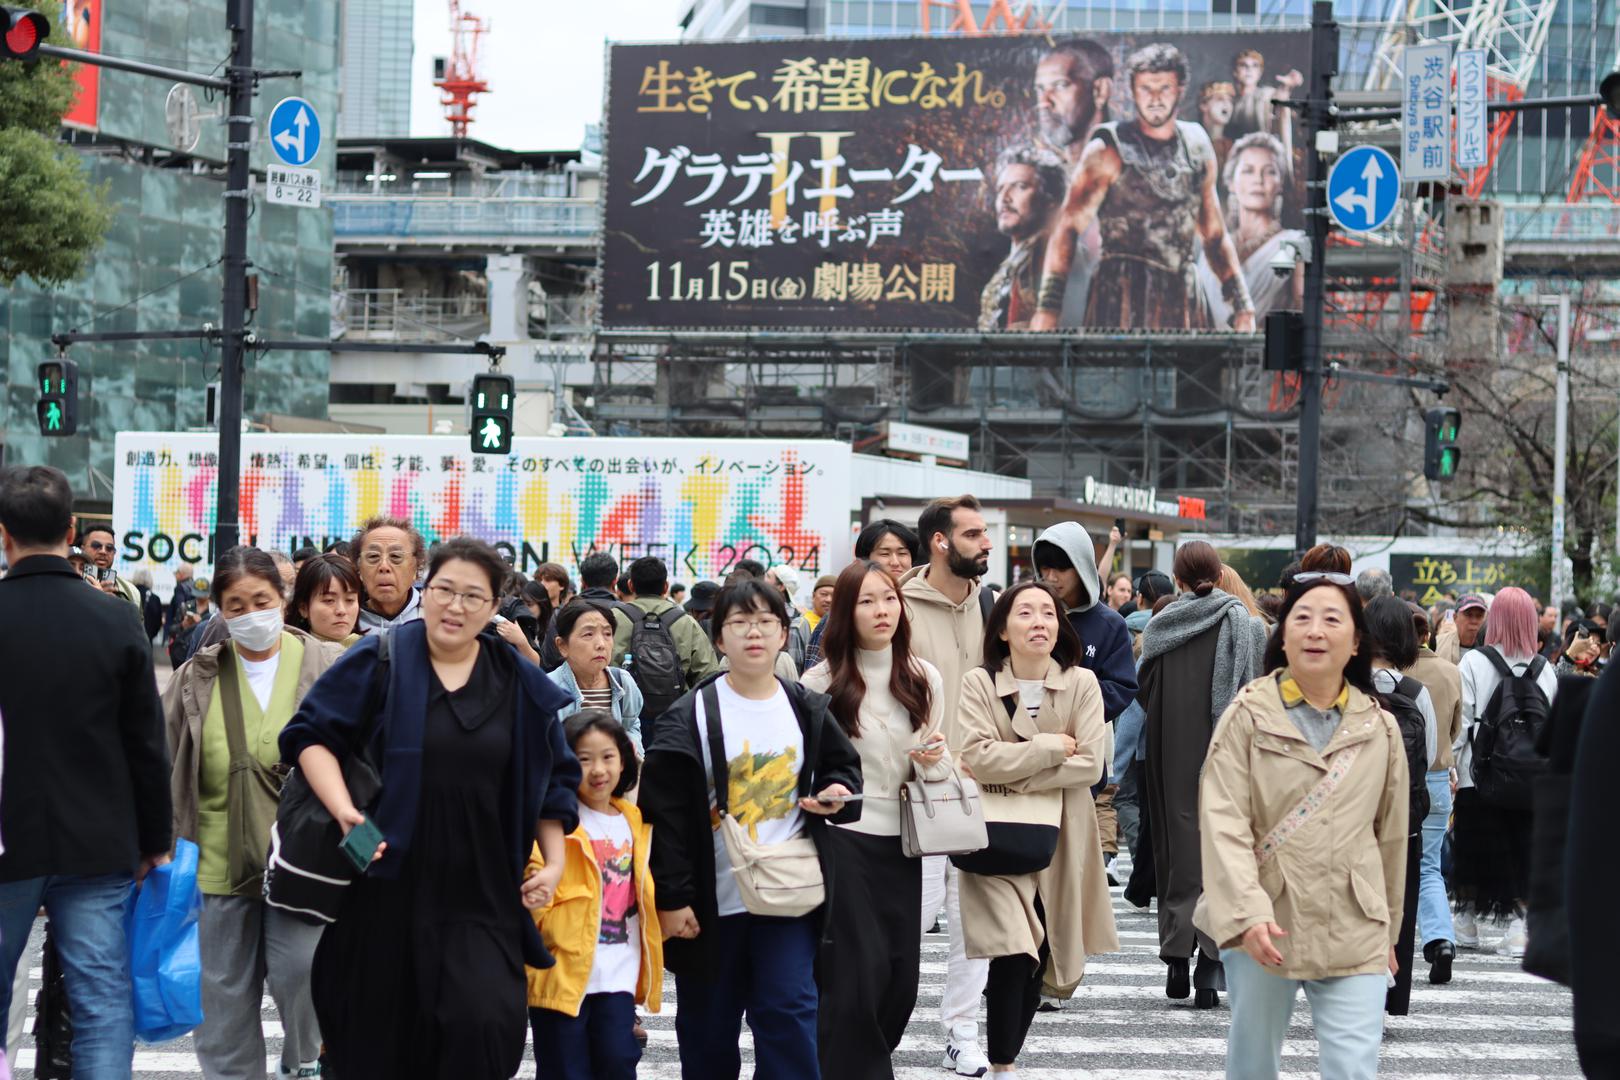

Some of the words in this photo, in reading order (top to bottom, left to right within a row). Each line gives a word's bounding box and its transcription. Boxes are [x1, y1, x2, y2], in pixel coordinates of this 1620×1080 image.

[637, 56, 1007, 114] 生きて、希望になれ。
[1408, 75, 1421, 126] Shibuya
[1423, 56, 1443, 169] 渋谷駅前
[1463, 54, 1479, 162] スクランブル式
[631, 143, 984, 207] グラディエーター
[699, 208, 905, 248] 英雄を呼ぶ声
[1085, 644, 1097, 658] NY
